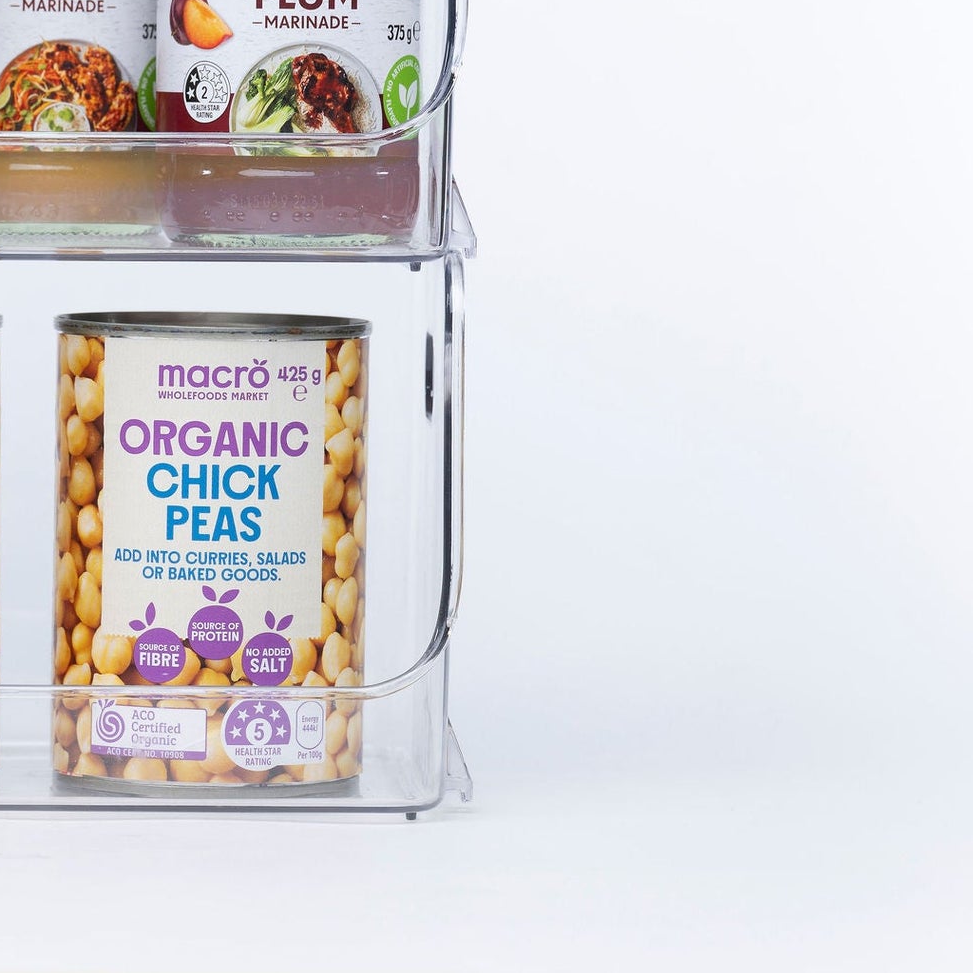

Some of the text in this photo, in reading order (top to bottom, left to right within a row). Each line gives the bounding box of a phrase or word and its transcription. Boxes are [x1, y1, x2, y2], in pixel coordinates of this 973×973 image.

[22, 0, 105, 13] MARINADE
[264, 16, 349, 29] MARINADE
[387, 24, 405, 41] 375
[406, 28, 412, 45] g
[201, 86, 208, 99] 2
[277, 366, 308, 382] 425
[312, 368, 321, 385] g
[158, 390, 269, 401] WHOLEFOODS MARKET
[119, 418, 309, 457] ORGANIC
[146, 462, 281, 500] CHICK
[166, 505, 262, 542] PEAS
[114, 548, 306, 566] ADD INTO CURRIES, SALADS
[142, 566, 282, 581] OR BAKED GOODS.
[191, 622, 240, 630] SOURCE OF
[191, 631, 239, 642] PROTEIN
[139, 643, 167, 651] SOURCE
[246, 647, 291, 657] NO ADDED
[139, 652, 179, 667] FIBRE
[250, 658, 287, 673] SALT
[132, 710, 155, 721] ACO
[301, 715, 319, 723] Energy
[131, 721, 181, 734] Certified
[254, 723, 264, 741] 5
[131, 734, 177, 747] Organic
[107, 747, 121, 756] ACO
[235, 747, 281, 756] HEALTH STAR
[297, 751, 322, 760] Per 100g
[245, 757, 272, 766] RATING
